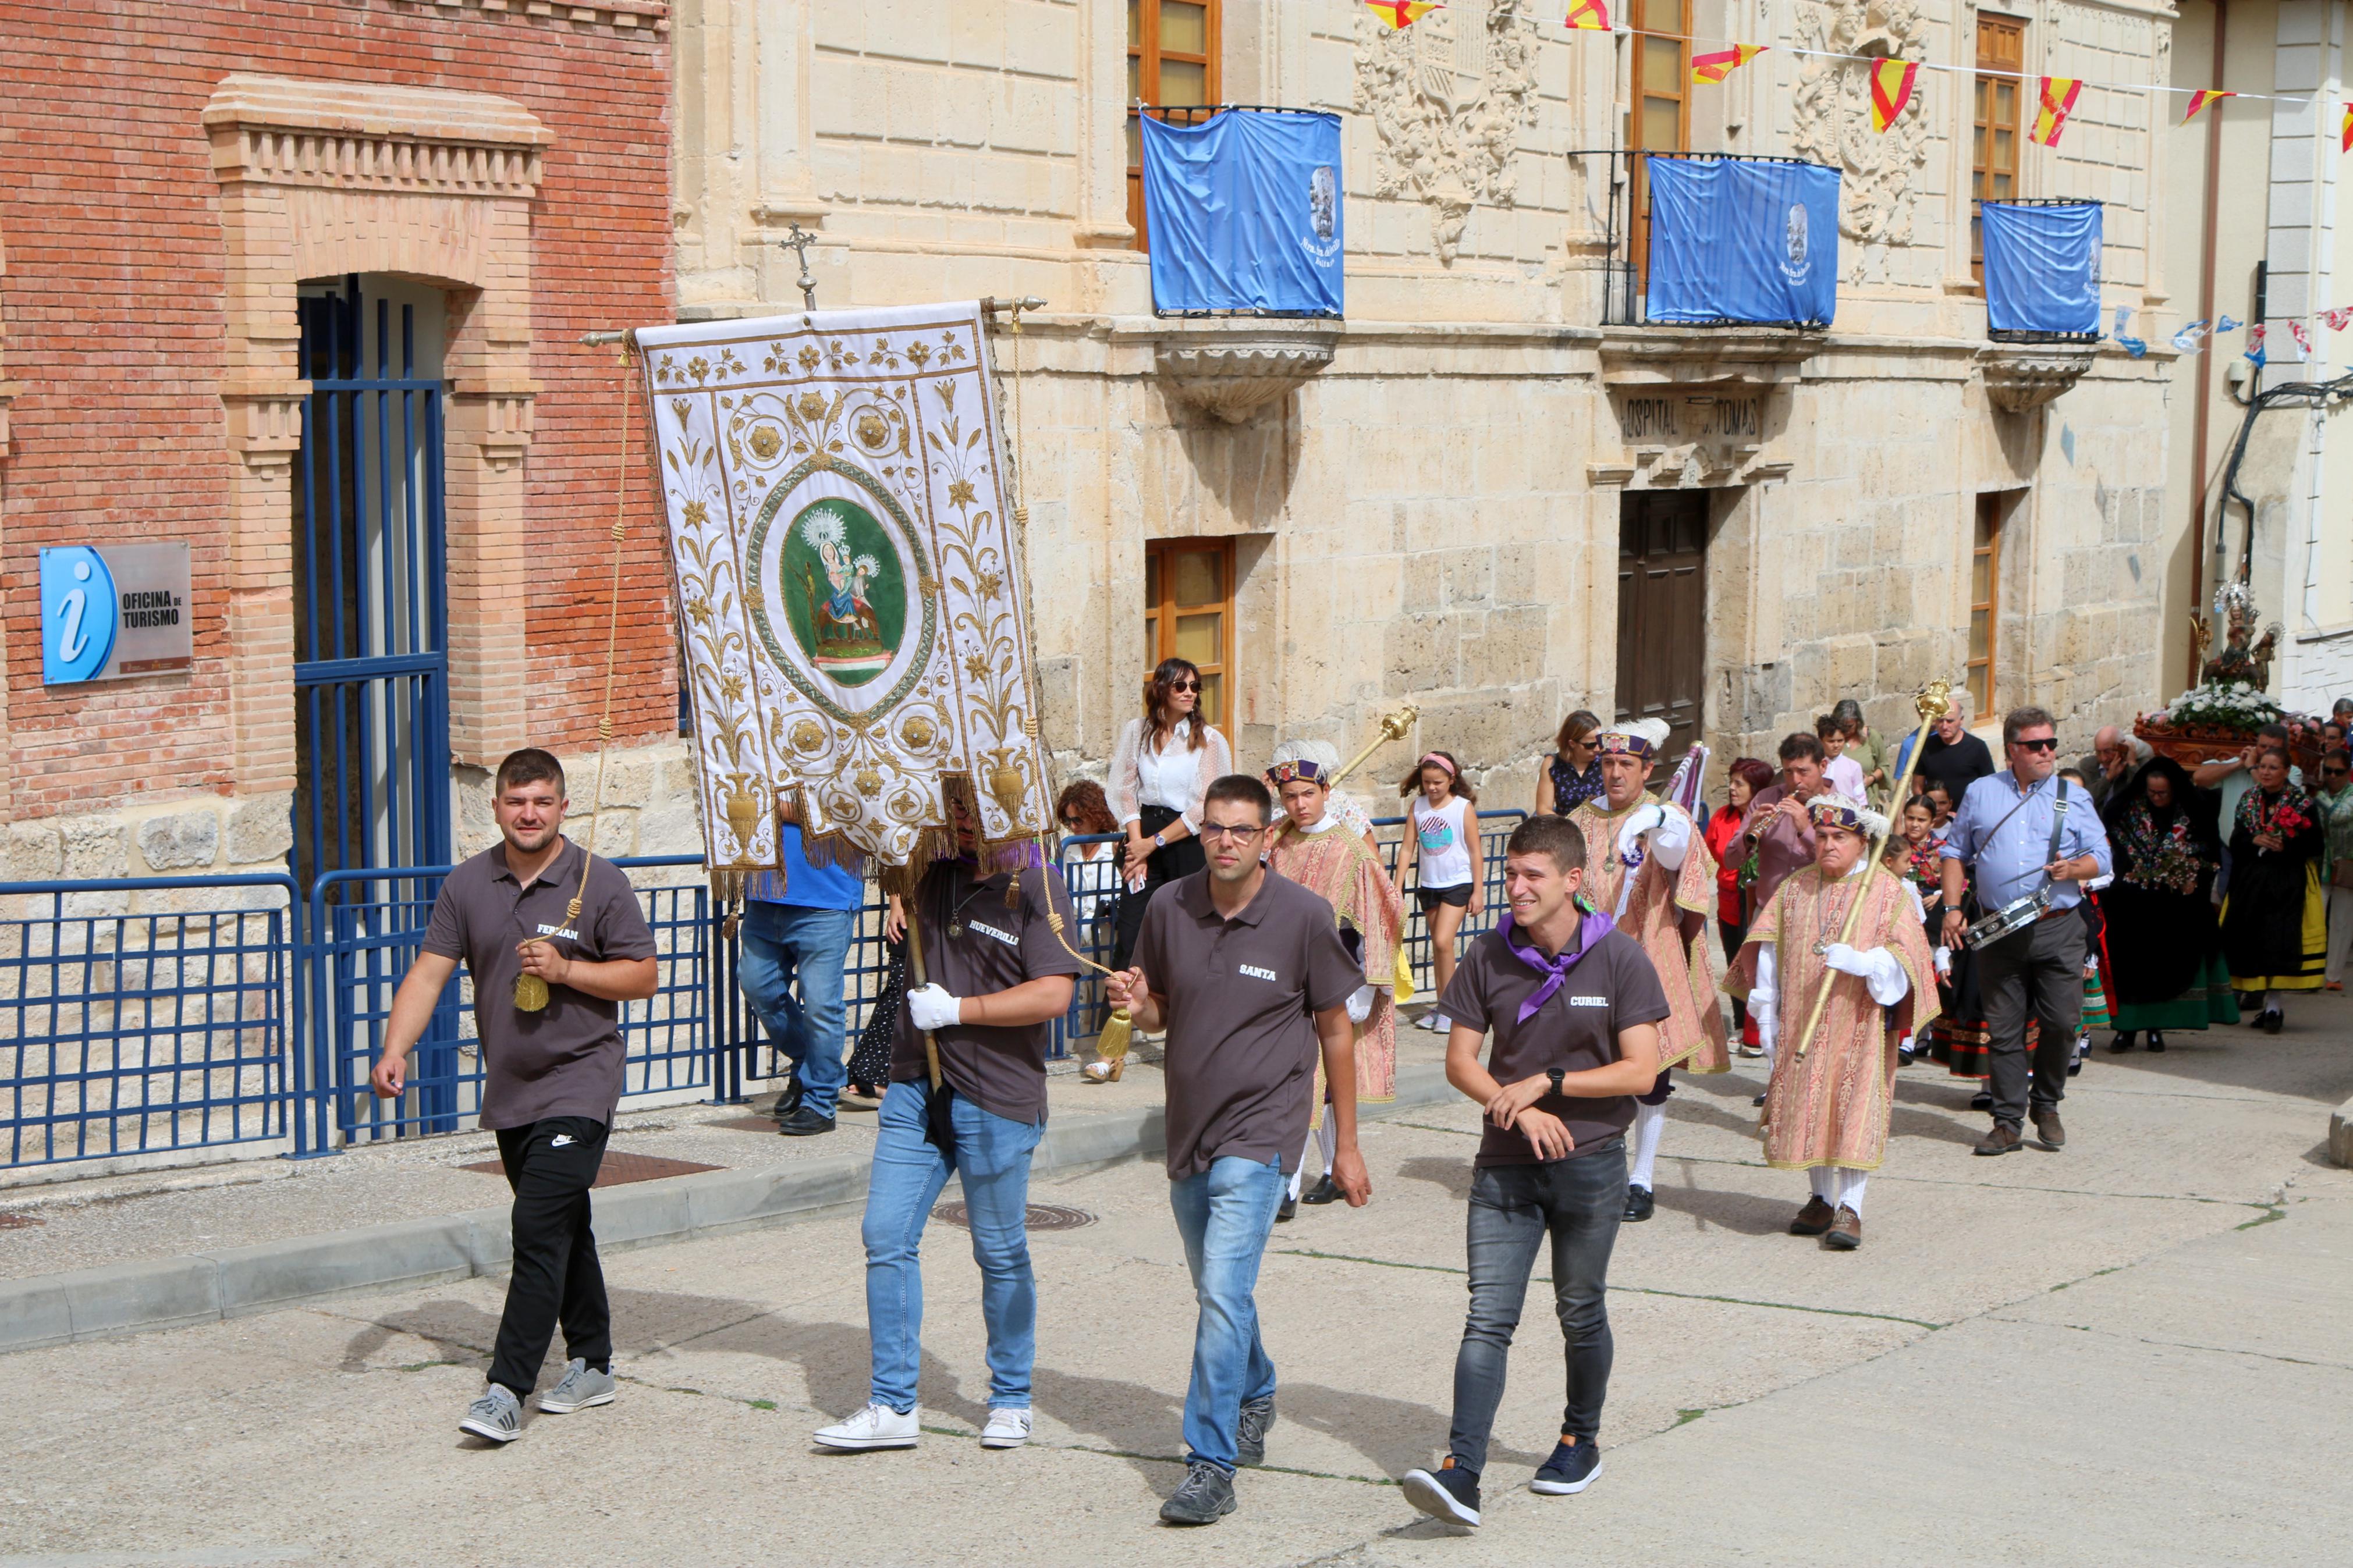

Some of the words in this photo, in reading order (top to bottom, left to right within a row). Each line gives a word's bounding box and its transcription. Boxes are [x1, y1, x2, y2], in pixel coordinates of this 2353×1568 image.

[1688, 470, 1695, 483] 16
[123, 591, 172, 610] OFICINA
[173, 597, 182, 606] DE
[123, 609, 179, 629] TURISMO
[1239, 963, 1276, 982] SANTA
[1570, 996, 1609, 1007] CURIEL
